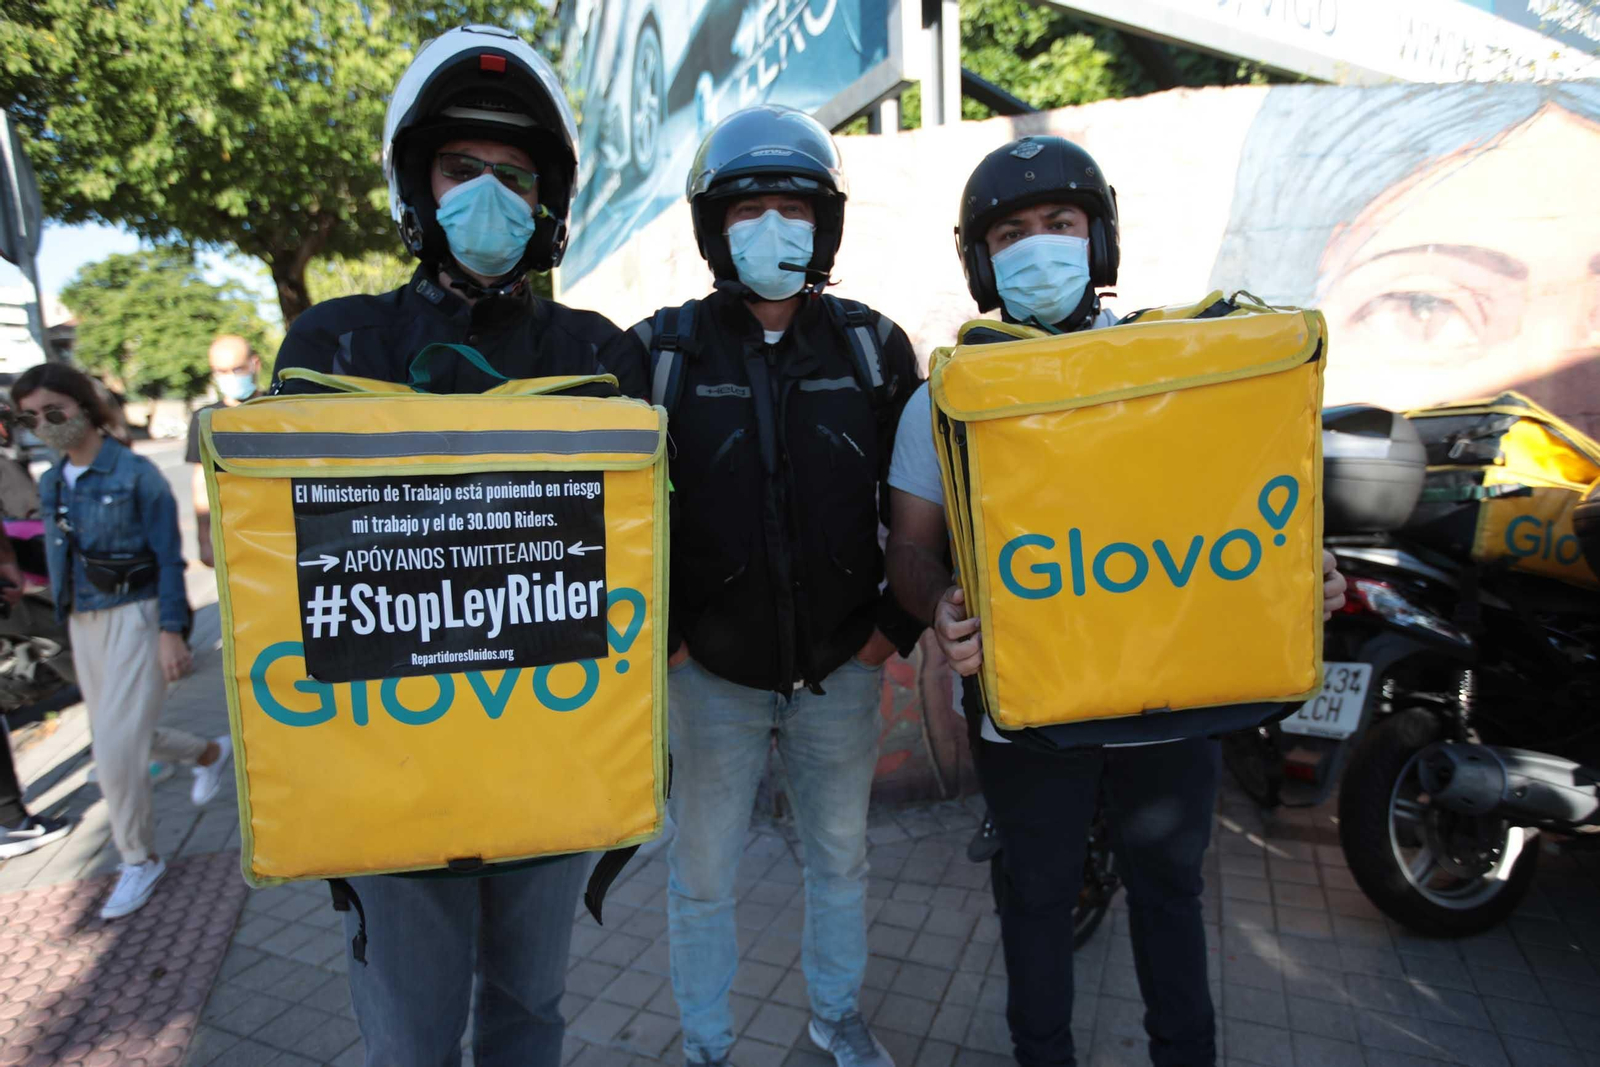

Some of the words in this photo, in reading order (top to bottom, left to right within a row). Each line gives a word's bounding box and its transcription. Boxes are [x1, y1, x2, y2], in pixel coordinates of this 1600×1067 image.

[295, 485, 308, 503] El
[311, 484, 380, 502] Ministerio
[383, 484, 400, 501] de
[402, 484, 452, 505] Trabajo
[455, 482, 483, 500] está
[486, 480, 542, 503] poniendo
[545, 483, 561, 497] en
[563, 479, 601, 499] riesgo
[352, 516, 369, 533] mi
[371, 514, 419, 536] trabajo
[422, 518, 430, 536] y
[433, 514, 445, 531] el
[448, 513, 464, 531] de
[467, 511, 511, 530] 30.000
[514, 511, 558, 529] Riders.
[344, 545, 445, 573] APÓYANOS
[449, 540, 564, 568] TWITTEANDO
[306, 571, 604, 643] #StopLeyRider
[411, 648, 515, 666] RepartidoresUnidos.org
